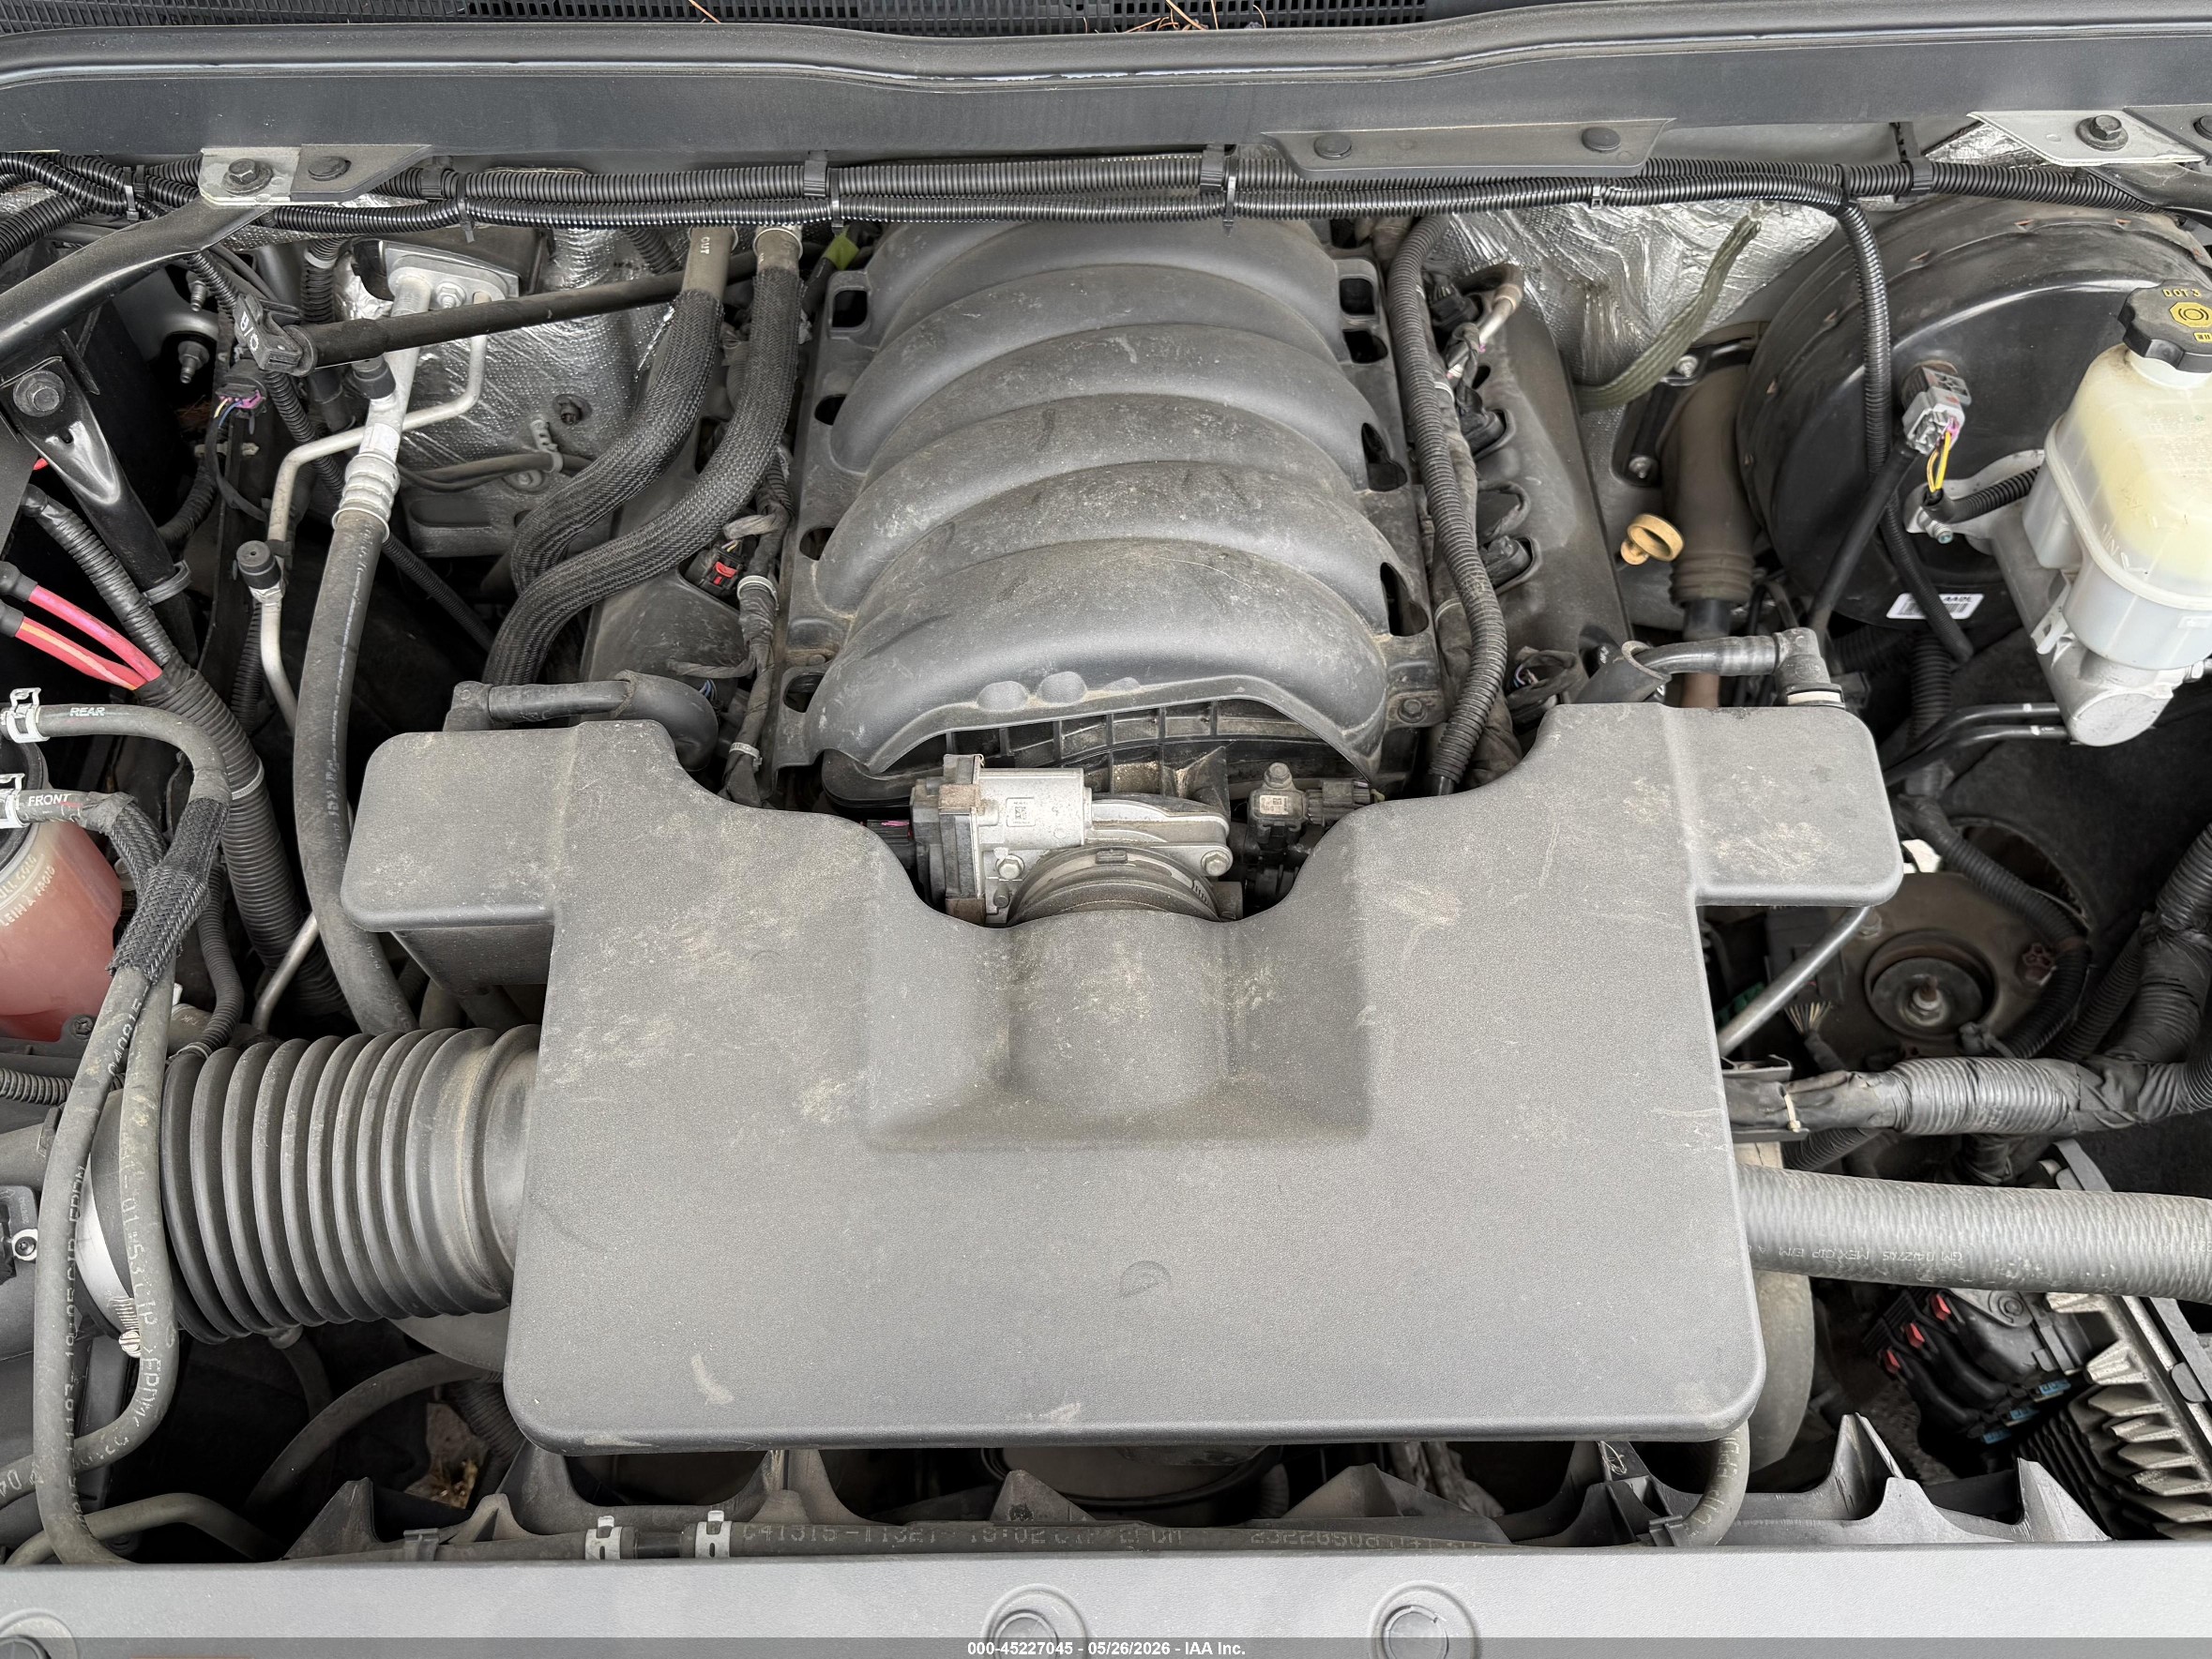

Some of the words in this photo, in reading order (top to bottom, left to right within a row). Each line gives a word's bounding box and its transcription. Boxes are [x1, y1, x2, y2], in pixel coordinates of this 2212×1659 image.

[700, 236, 711, 255] OUT
[2162, 288, 2189, 298] DOT
[2190, 288, 2203, 298] 3
[69, 706, 106, 717] REAR
[27, 792, 72, 807] FRONT
[0, 903, 28, 928] LEIN
[34, 864, 56, 897] FROID
